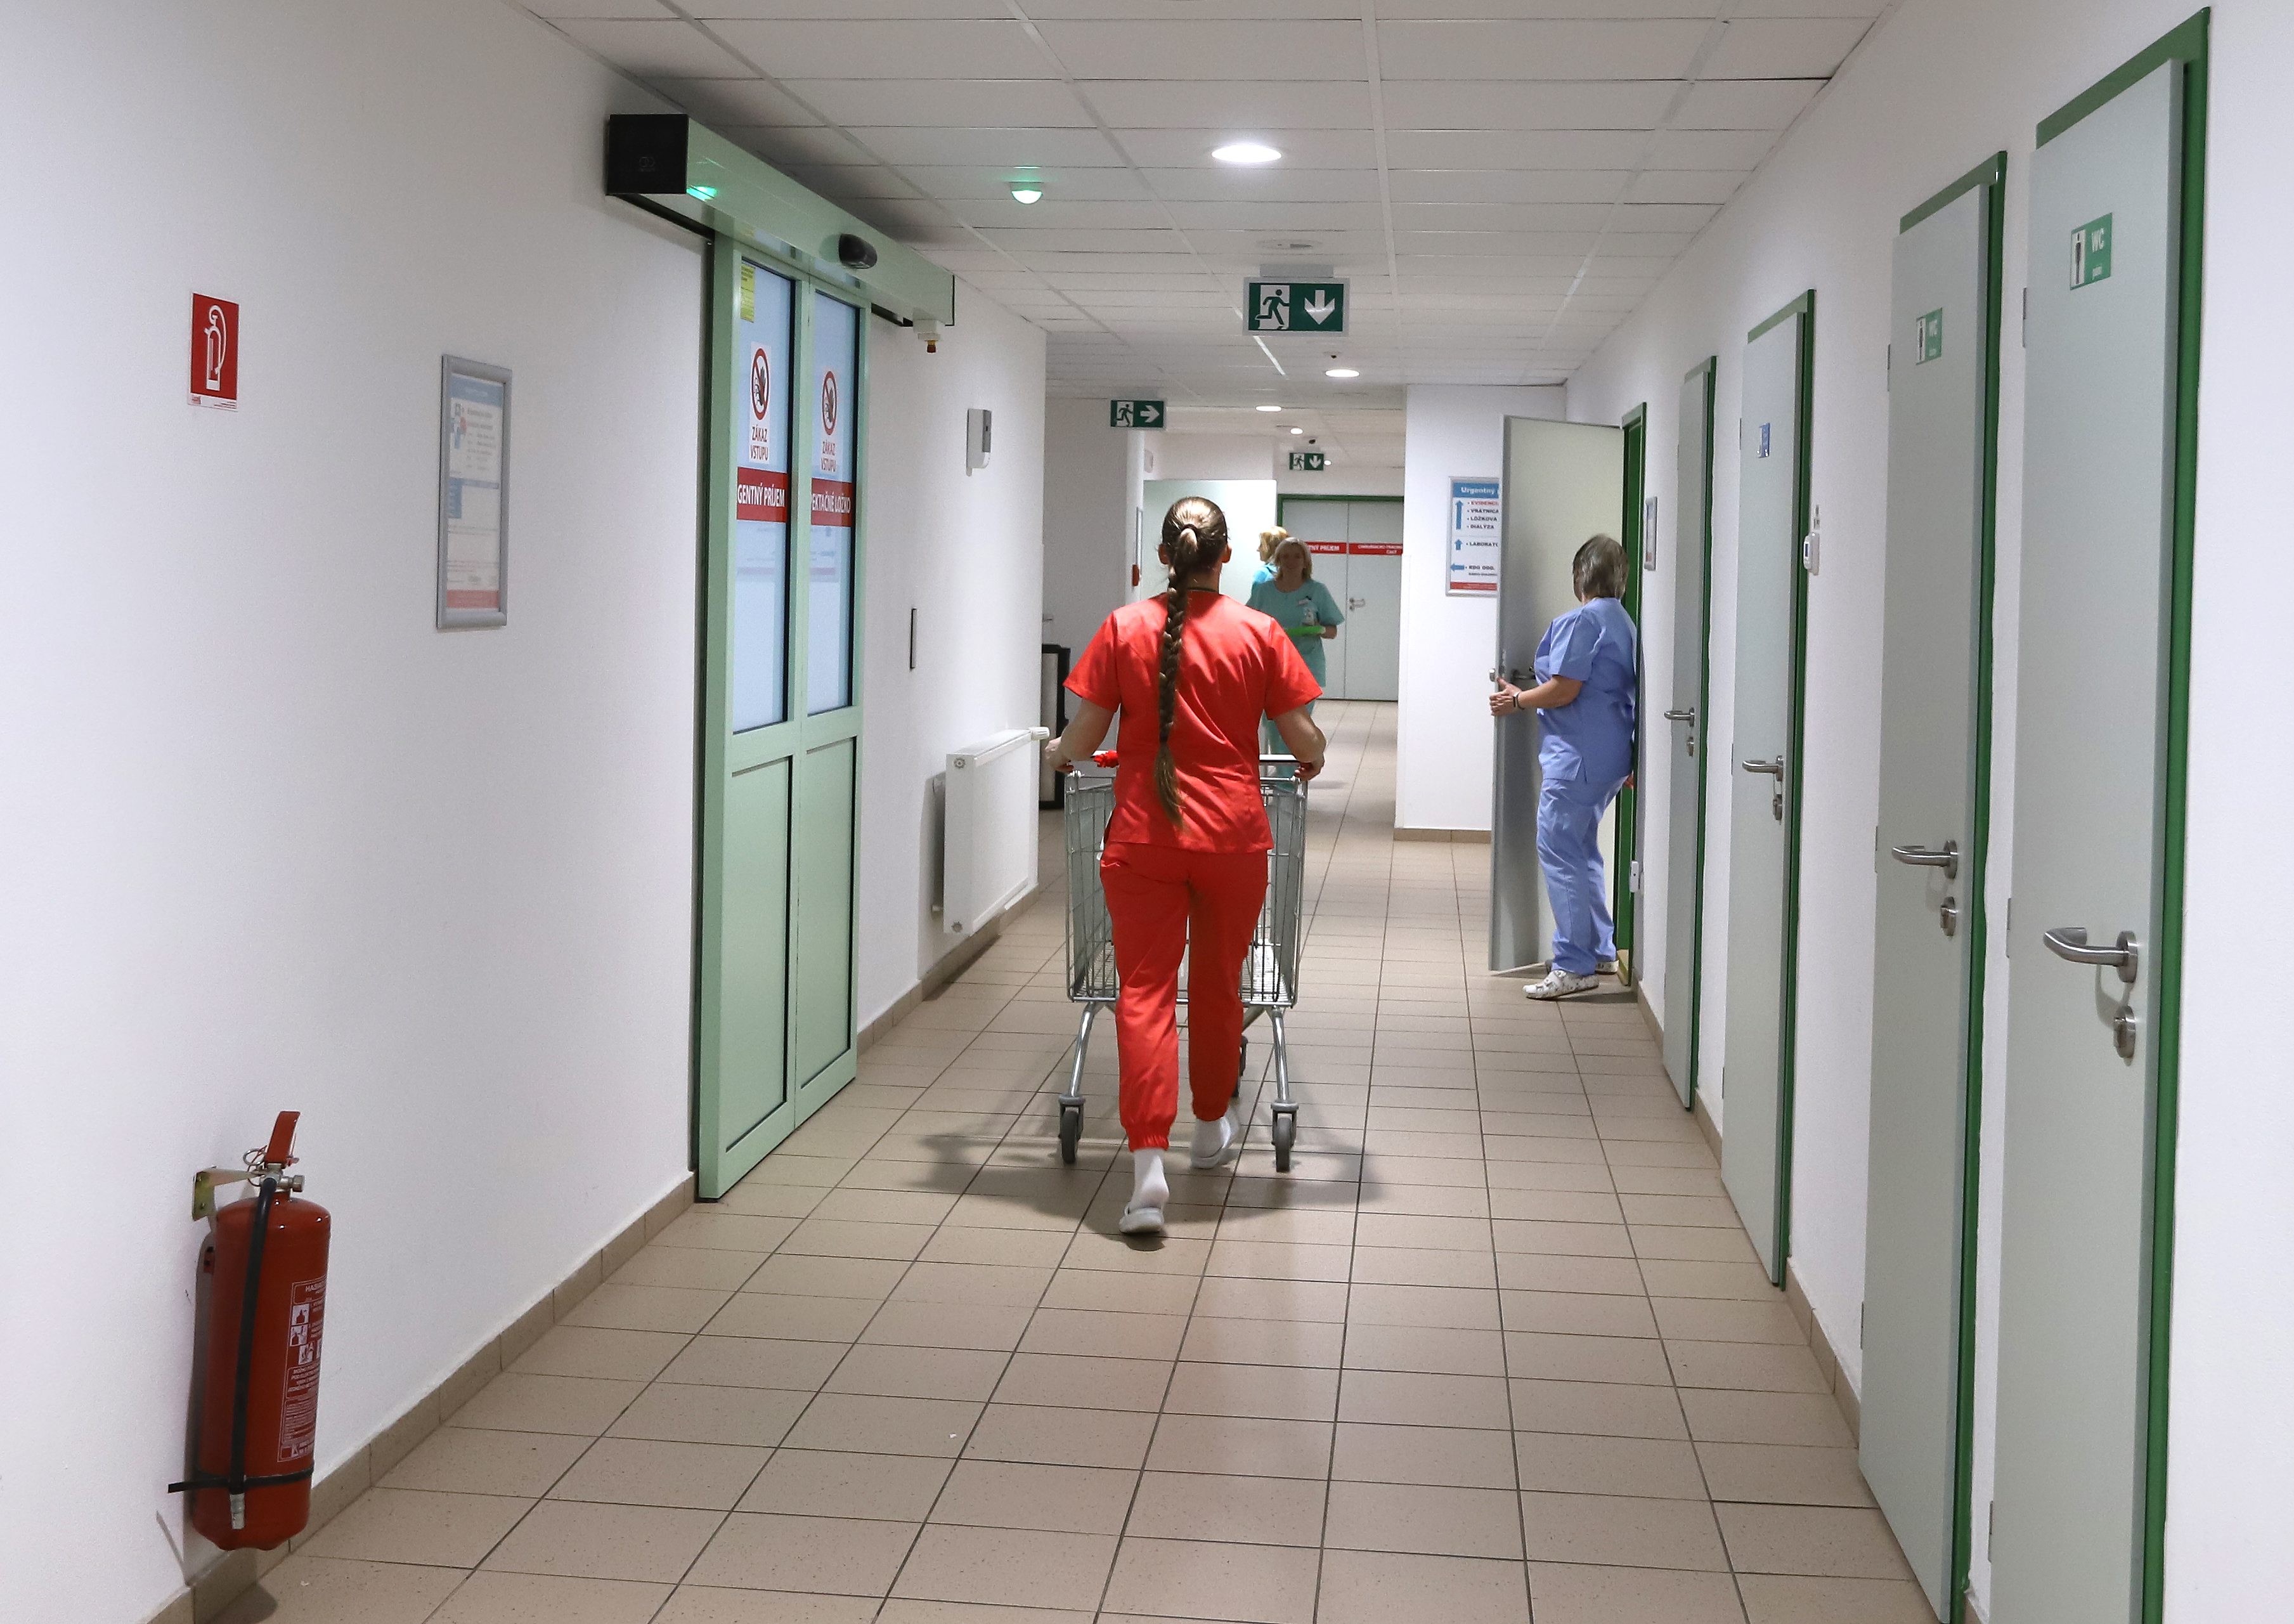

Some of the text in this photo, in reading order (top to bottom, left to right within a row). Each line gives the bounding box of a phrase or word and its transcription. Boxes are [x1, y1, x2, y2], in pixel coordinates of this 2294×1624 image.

[752, 424, 767, 443] ZÁKAZ
[750, 445, 768, 461] VSTUPU
[822, 439, 835, 456] ZÁKAZ
[820, 457, 836, 472] VSTUPU
[763, 484, 785, 507] PRÍJEM
